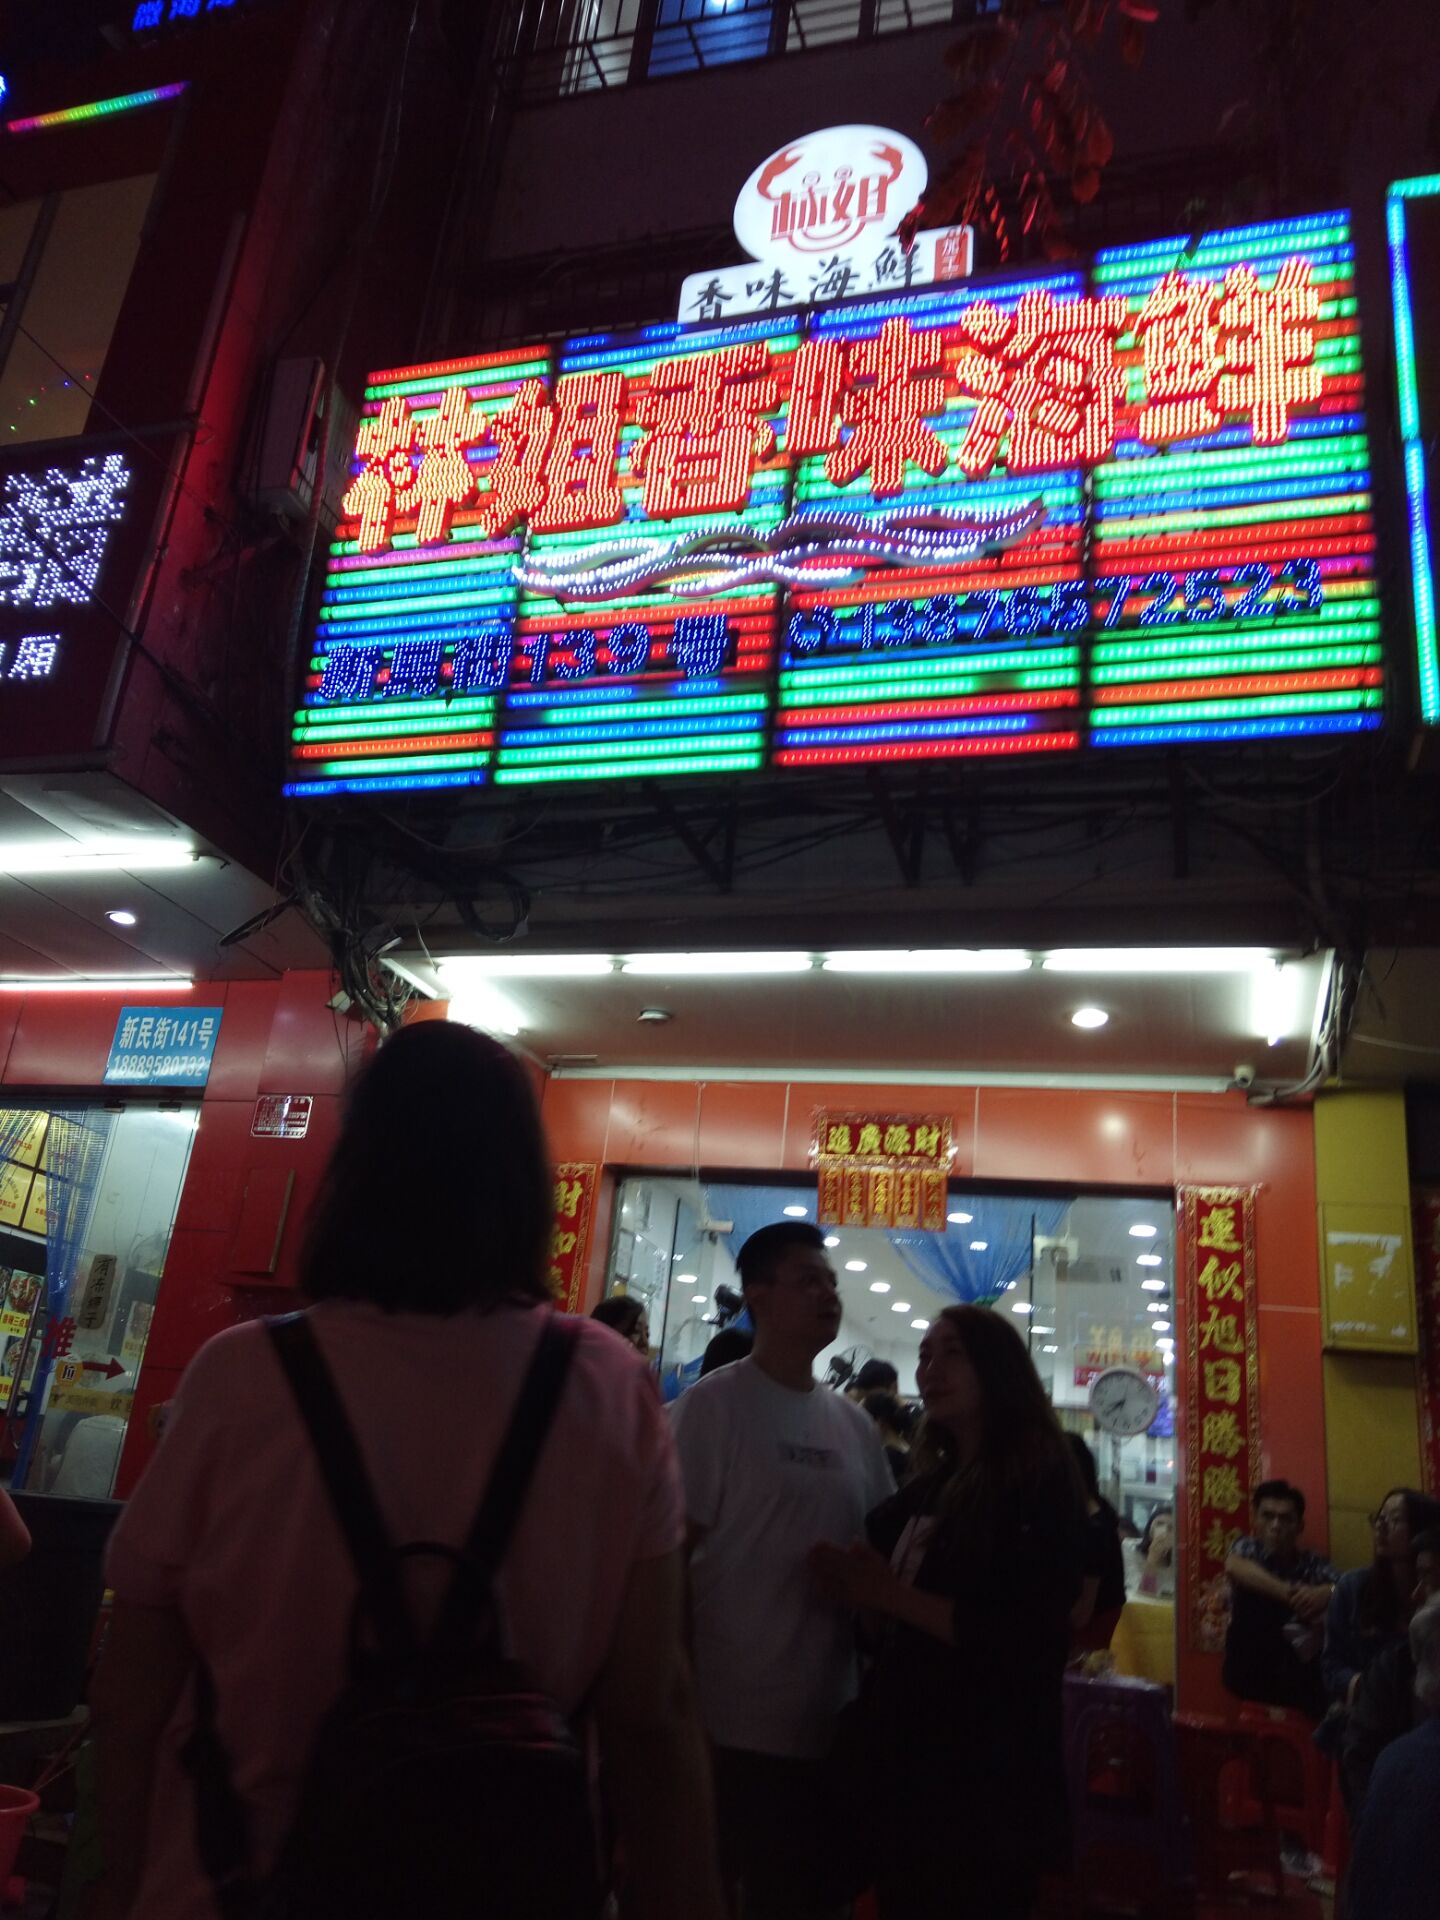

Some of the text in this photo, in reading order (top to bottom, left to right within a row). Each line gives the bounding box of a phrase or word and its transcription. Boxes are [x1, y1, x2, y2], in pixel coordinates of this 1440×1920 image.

[341, 256, 1322, 552] 林姐香味海鲜
[853, 557, 1323, 649] 13876572523
[119, 1016, 214, 1050] 新民街141号
